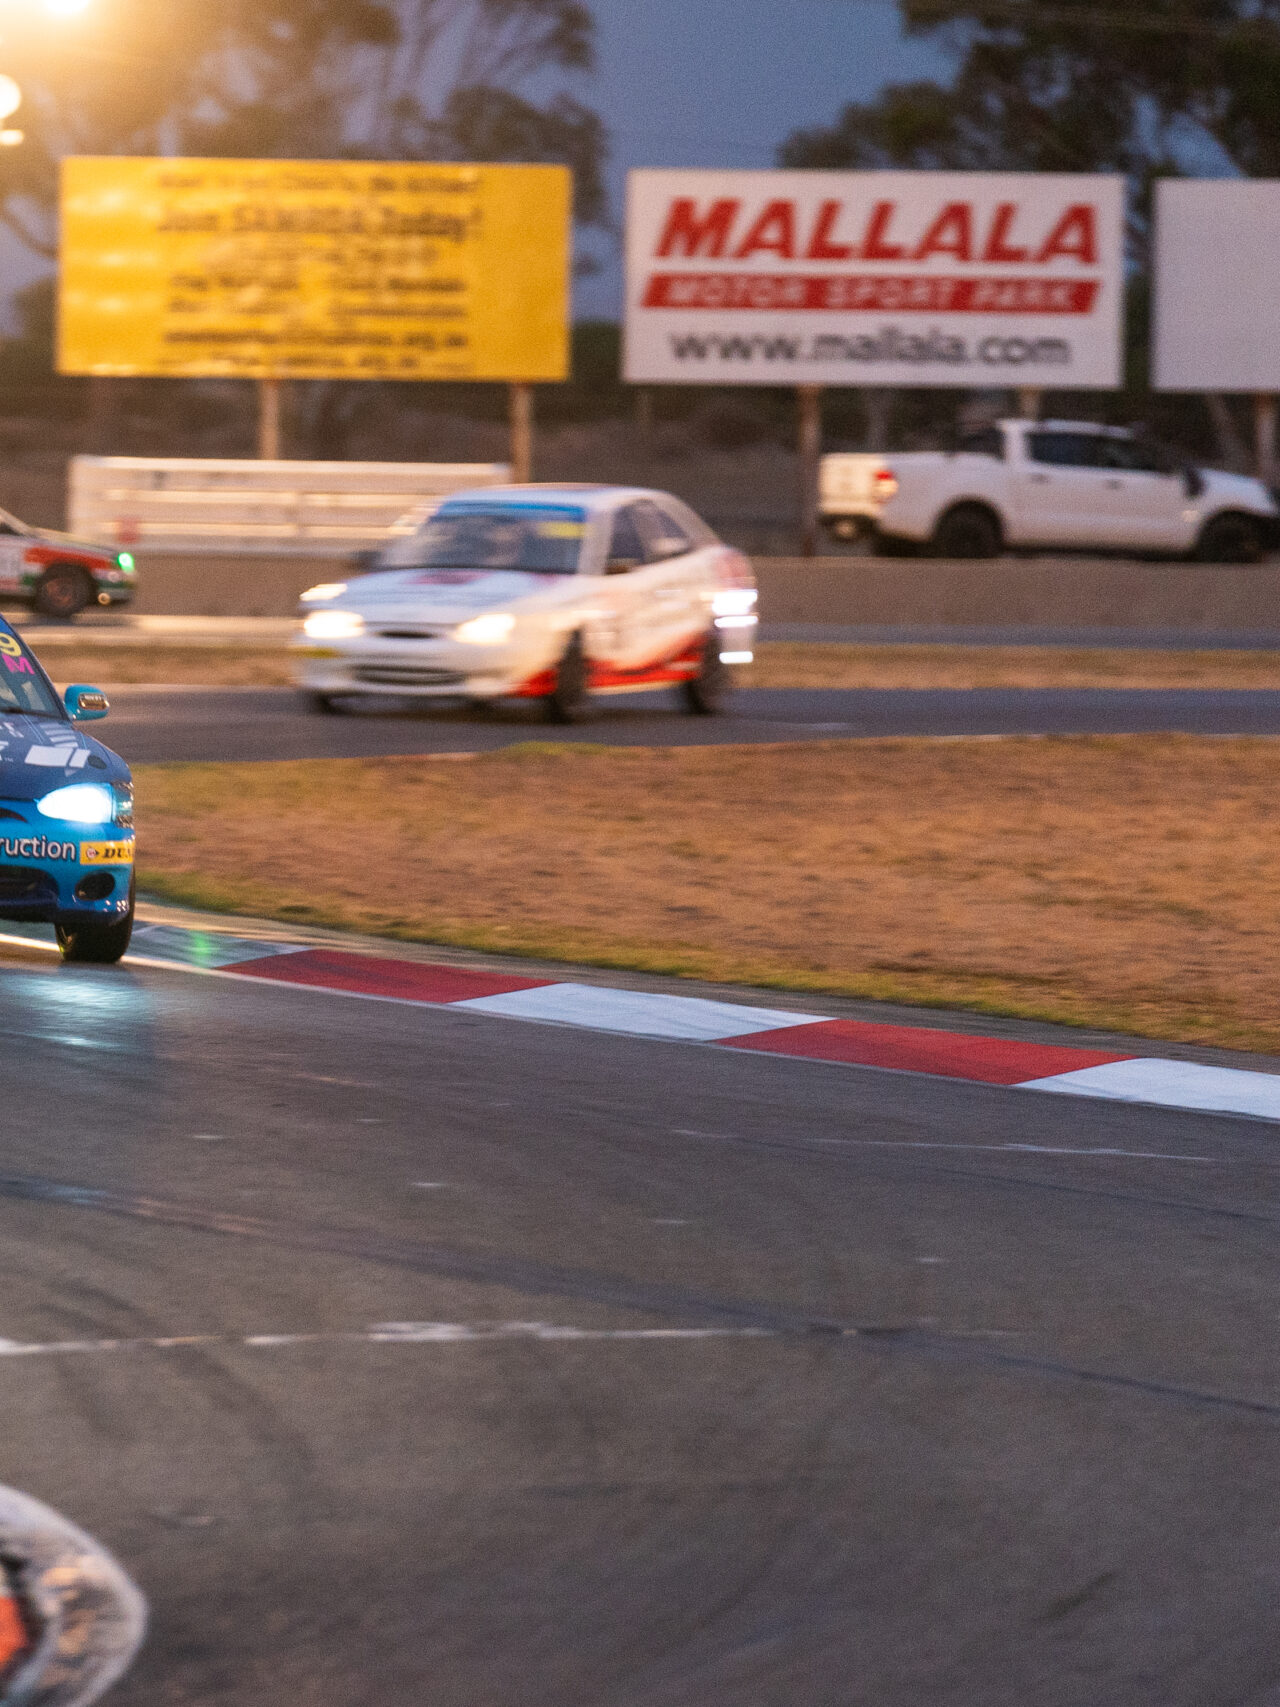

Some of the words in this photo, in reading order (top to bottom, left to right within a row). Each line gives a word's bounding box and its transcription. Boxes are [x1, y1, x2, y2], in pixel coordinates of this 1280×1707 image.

[654, 197, 1098, 264] MALLALA
[669, 326, 1073, 366] www.mallala.com
[1, 652, 35, 675] M
[102, 847, 131, 859] DU
